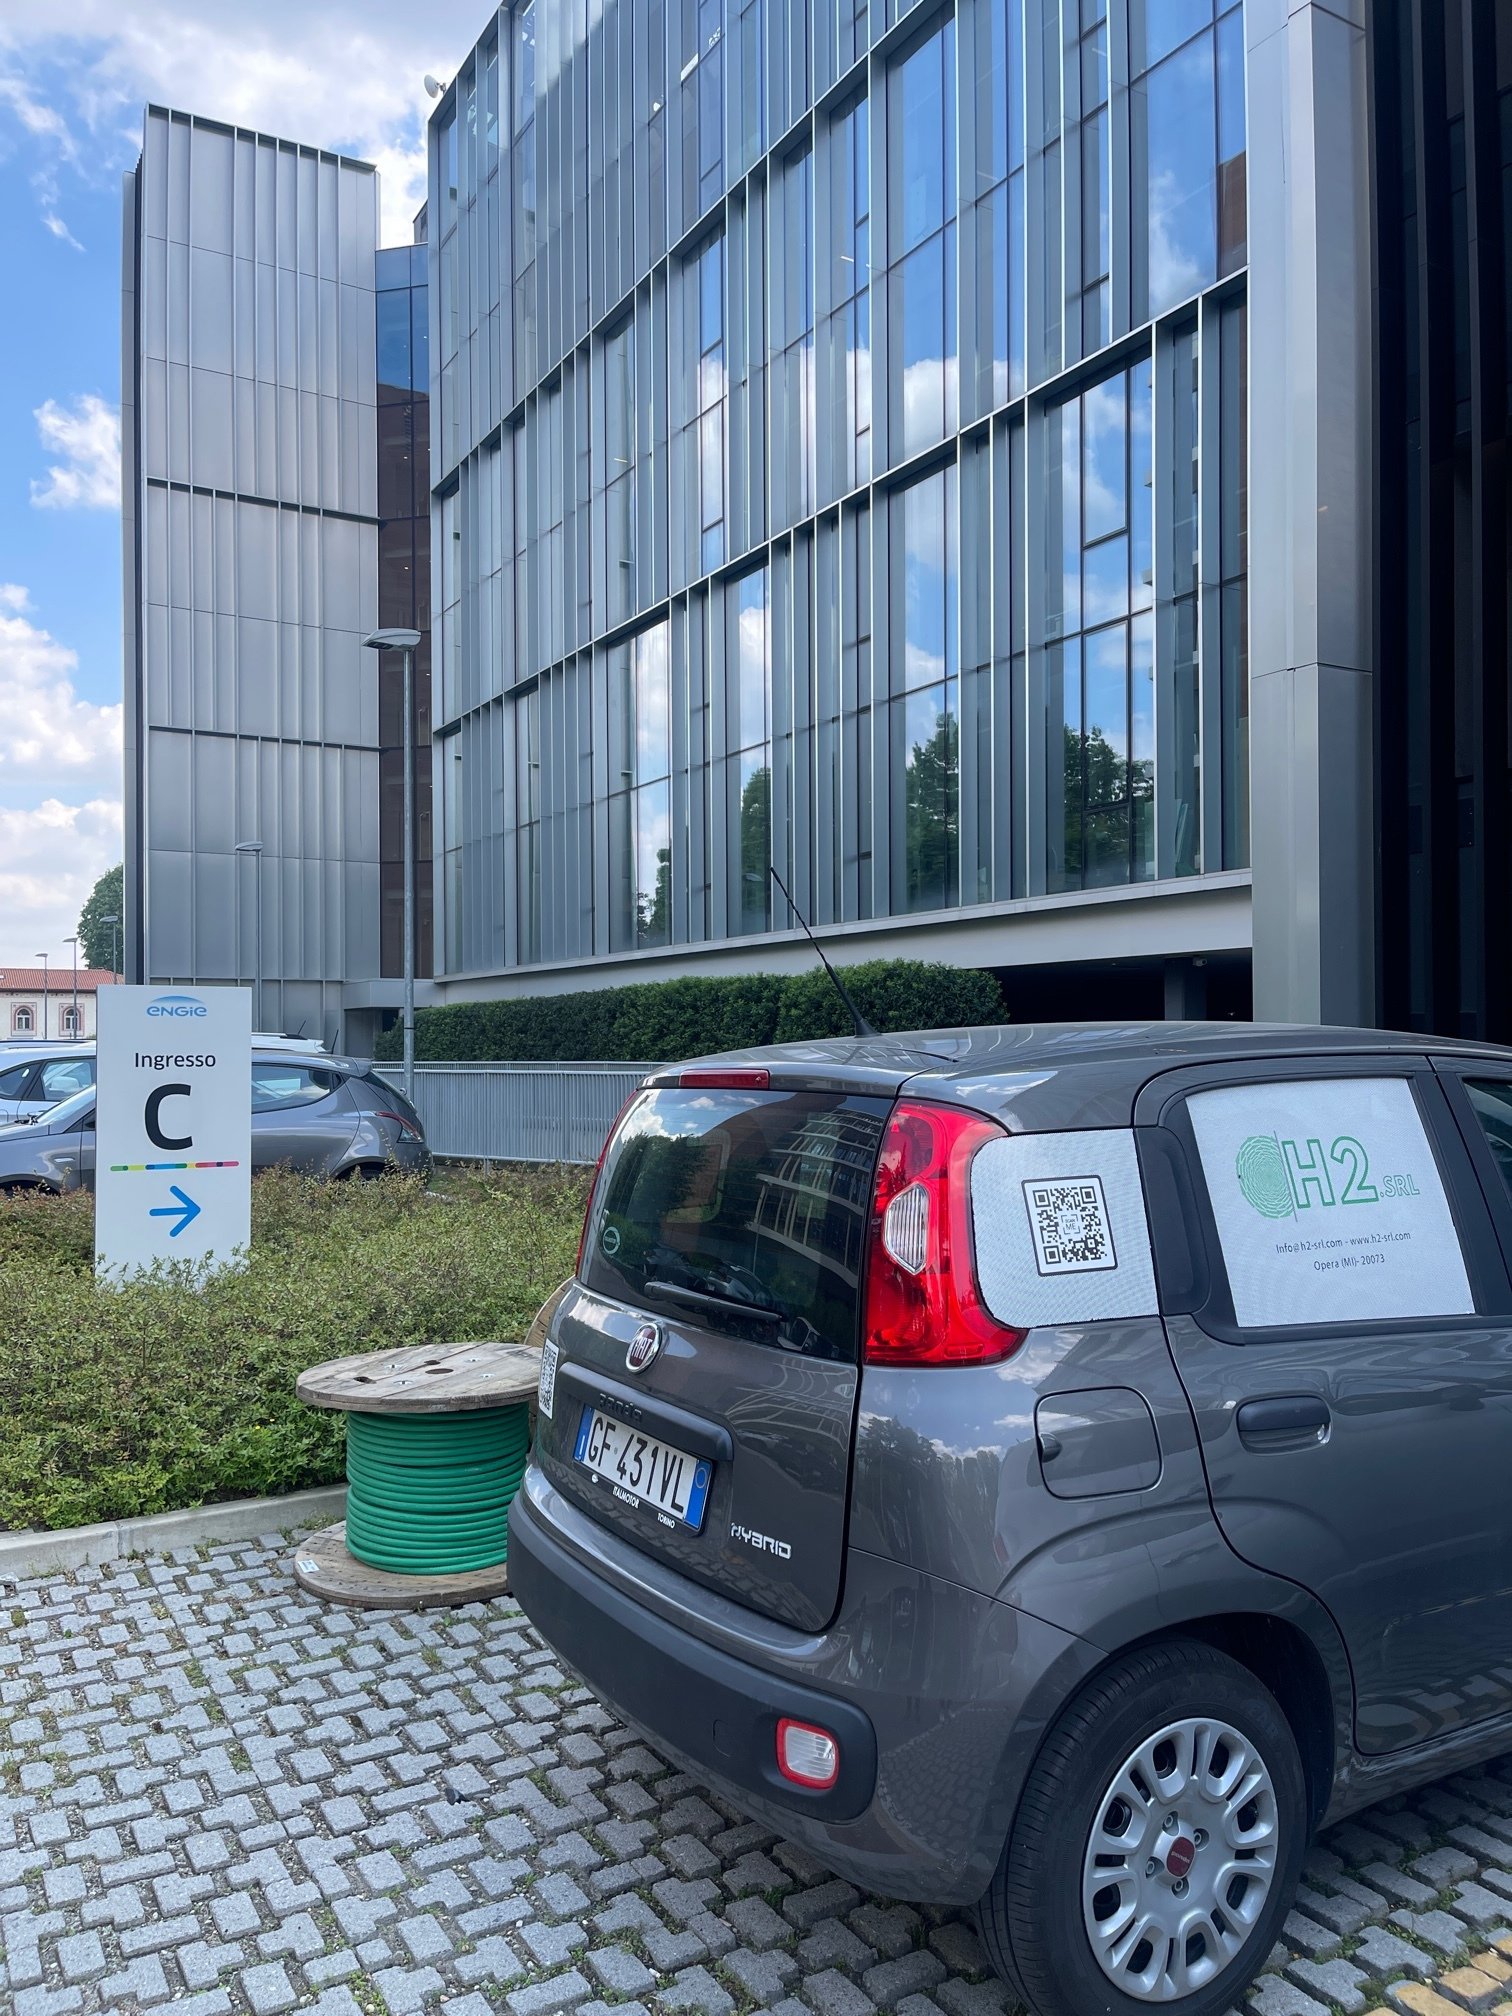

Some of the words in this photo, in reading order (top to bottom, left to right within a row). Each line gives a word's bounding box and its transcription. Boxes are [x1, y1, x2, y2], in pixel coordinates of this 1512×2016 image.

[134, 1052, 217, 1070] Ingresso
[144, 1083, 193, 1151] C
[1276, 1238, 1343, 1254] Info@h2-srl.com
[1349, 1231, 1411, 1246] www.h2-srl.com
[1313, 1259, 1340, 1272] Opera
[1361, 1253, 1385, 1266] 20073
[630, 1336, 654, 1361] FIAT
[657, 1512, 675, 1529] TORINO
[730, 1522, 792, 1560] HYBRID
